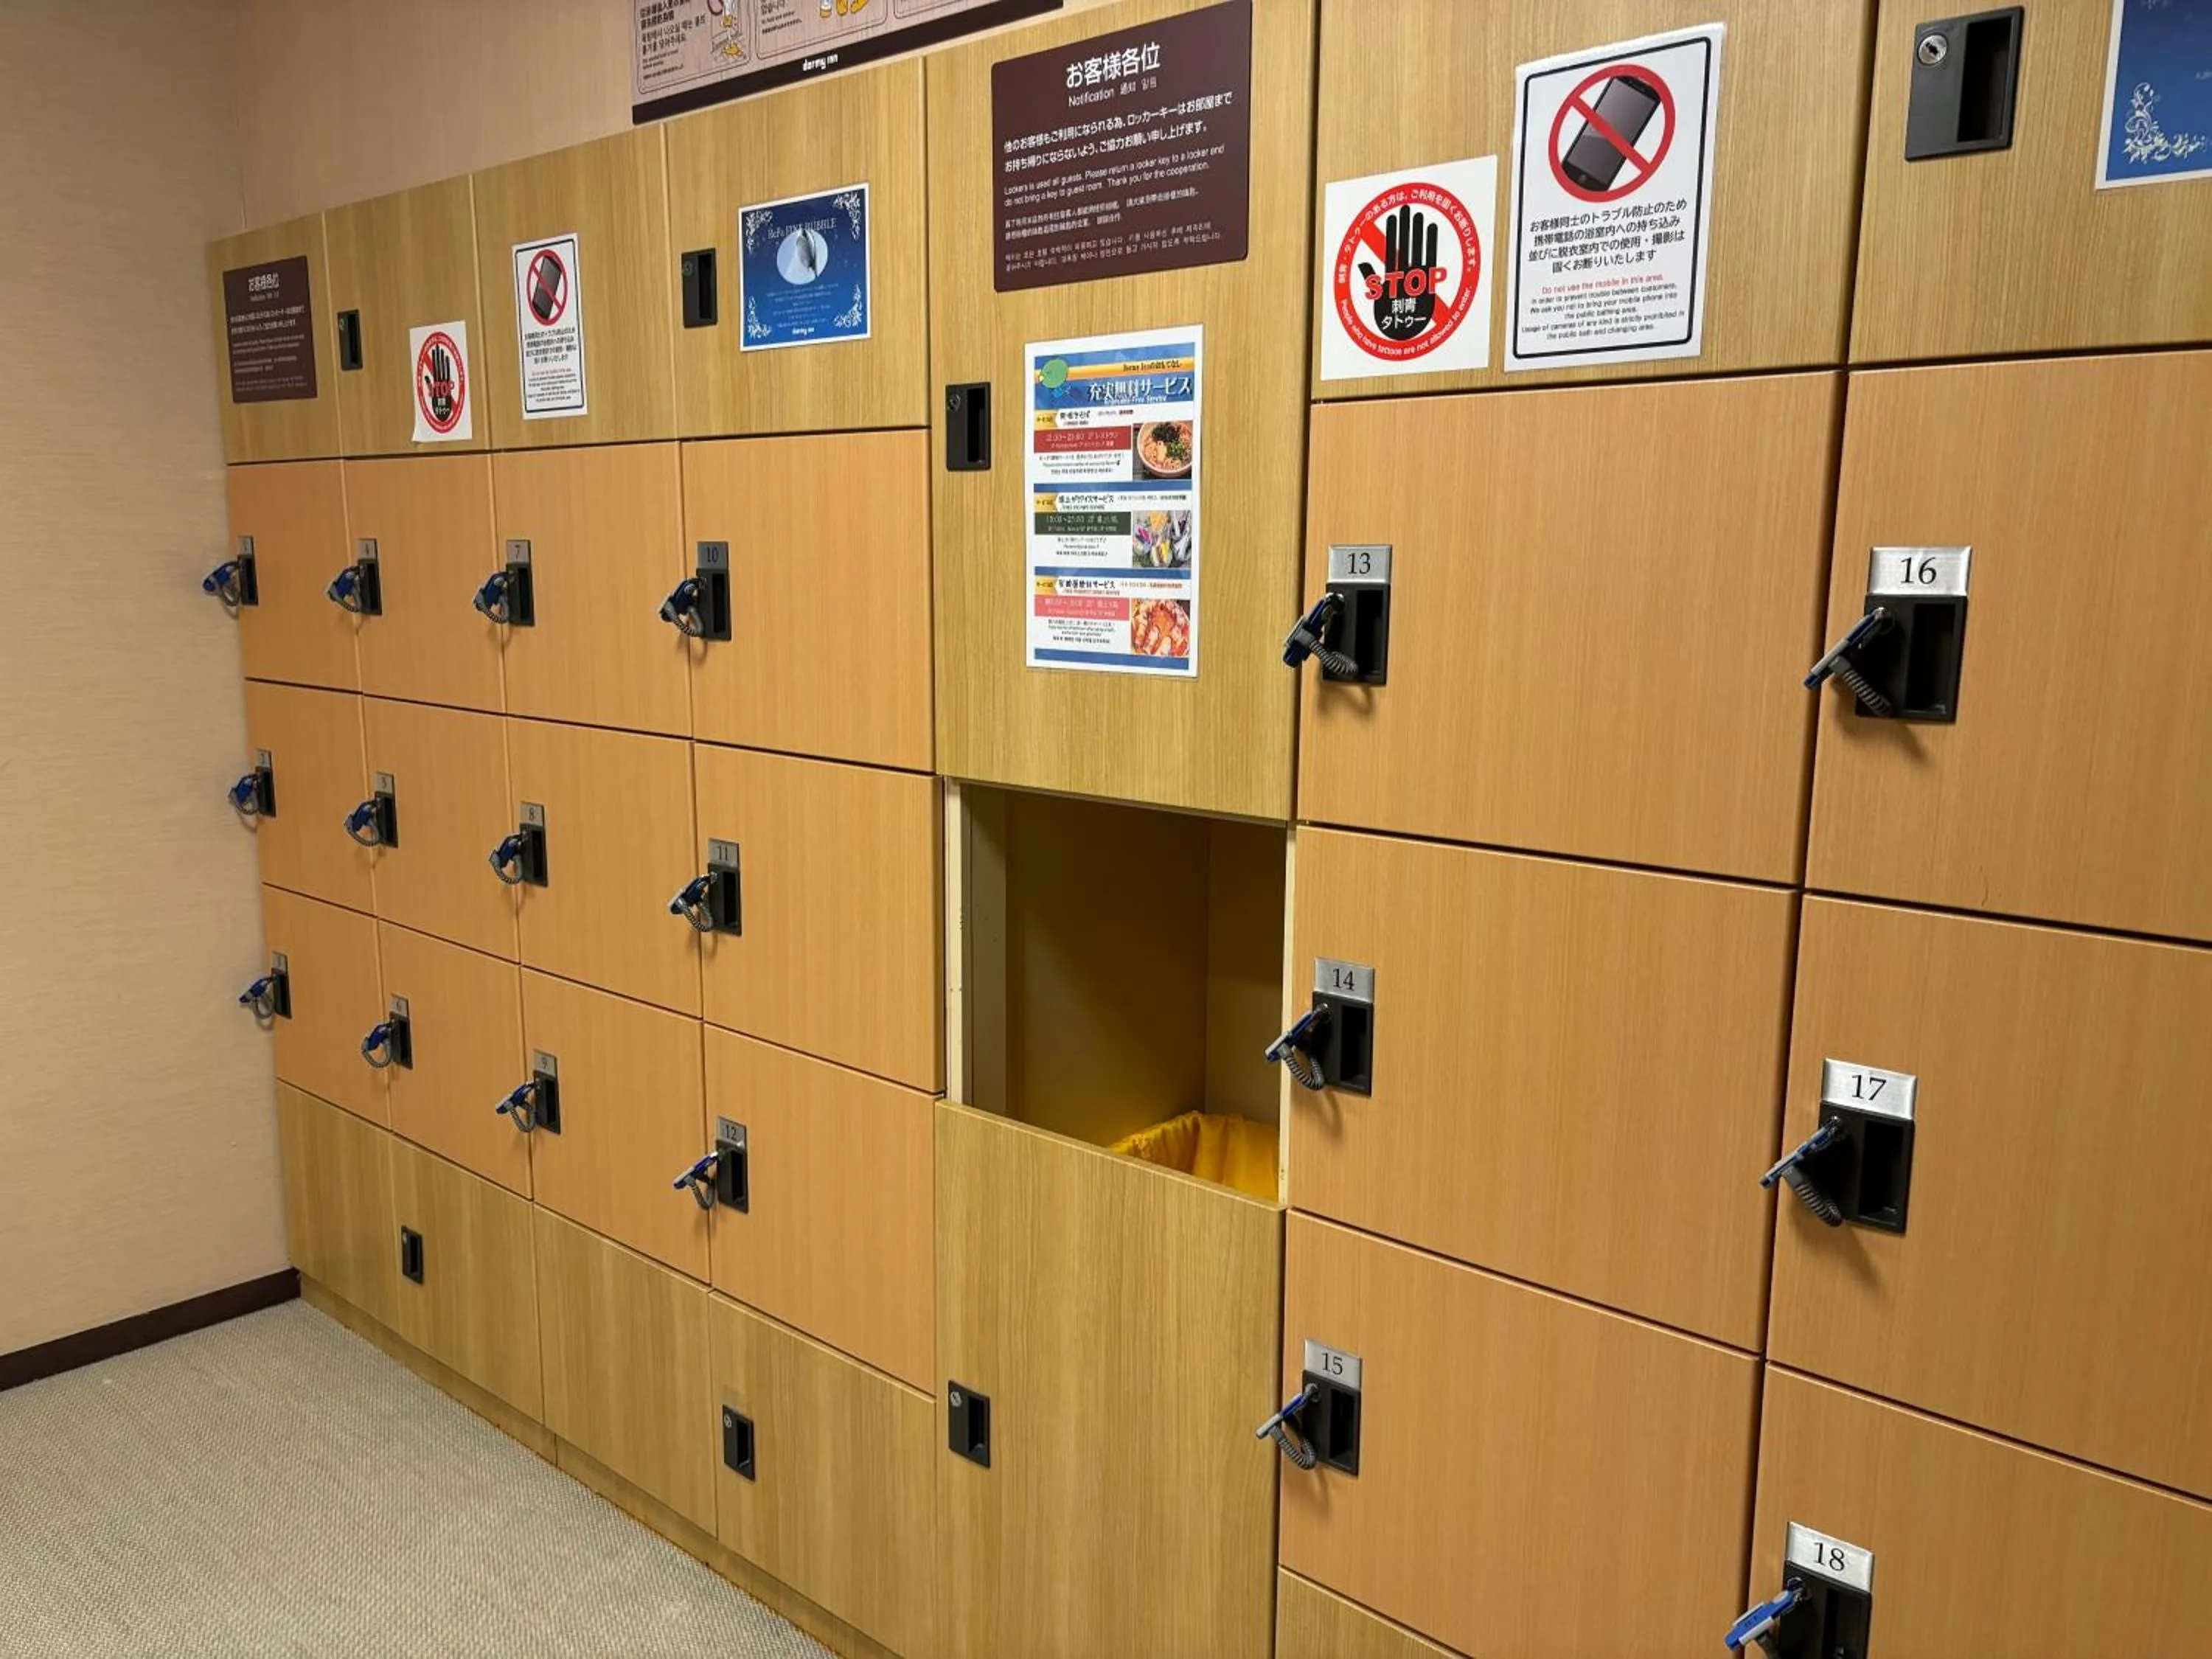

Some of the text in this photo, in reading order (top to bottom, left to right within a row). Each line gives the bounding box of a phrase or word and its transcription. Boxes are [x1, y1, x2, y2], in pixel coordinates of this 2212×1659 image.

[802, 59, 826, 72] dormy
[1066, 41, 1161, 88] お客様各位
[1068, 88, 1114, 106] Notification
[1530, 198, 1687, 232] お客様同士のトラブル防止のため
[1534, 215, 1680, 246] 携帯電話の浴室内への持ち込み
[1528, 229, 1684, 261] 並びに脱衣室内での使用・撮影は
[1552, 249, 1657, 274] 固くお断りいたします
[1365, 267, 1447, 300] STOP
[1392, 298, 1416, 313] 刺青
[1381, 316, 1426, 330] タトゥー
[1089, 377, 1192, 400] 充実無料サービス
[706, 546, 719, 563] 10
[1348, 552, 1371, 574] 13
[1900, 557, 1937, 585] 16
[717, 845, 728, 861] 11
[1332, 968, 1354, 991] 14
[1851, 1074, 1887, 1101] 17
[726, 1124, 737, 1141] 12
[1321, 1352, 1343, 1375] 15
[1814, 1542, 1845, 1571] 18
